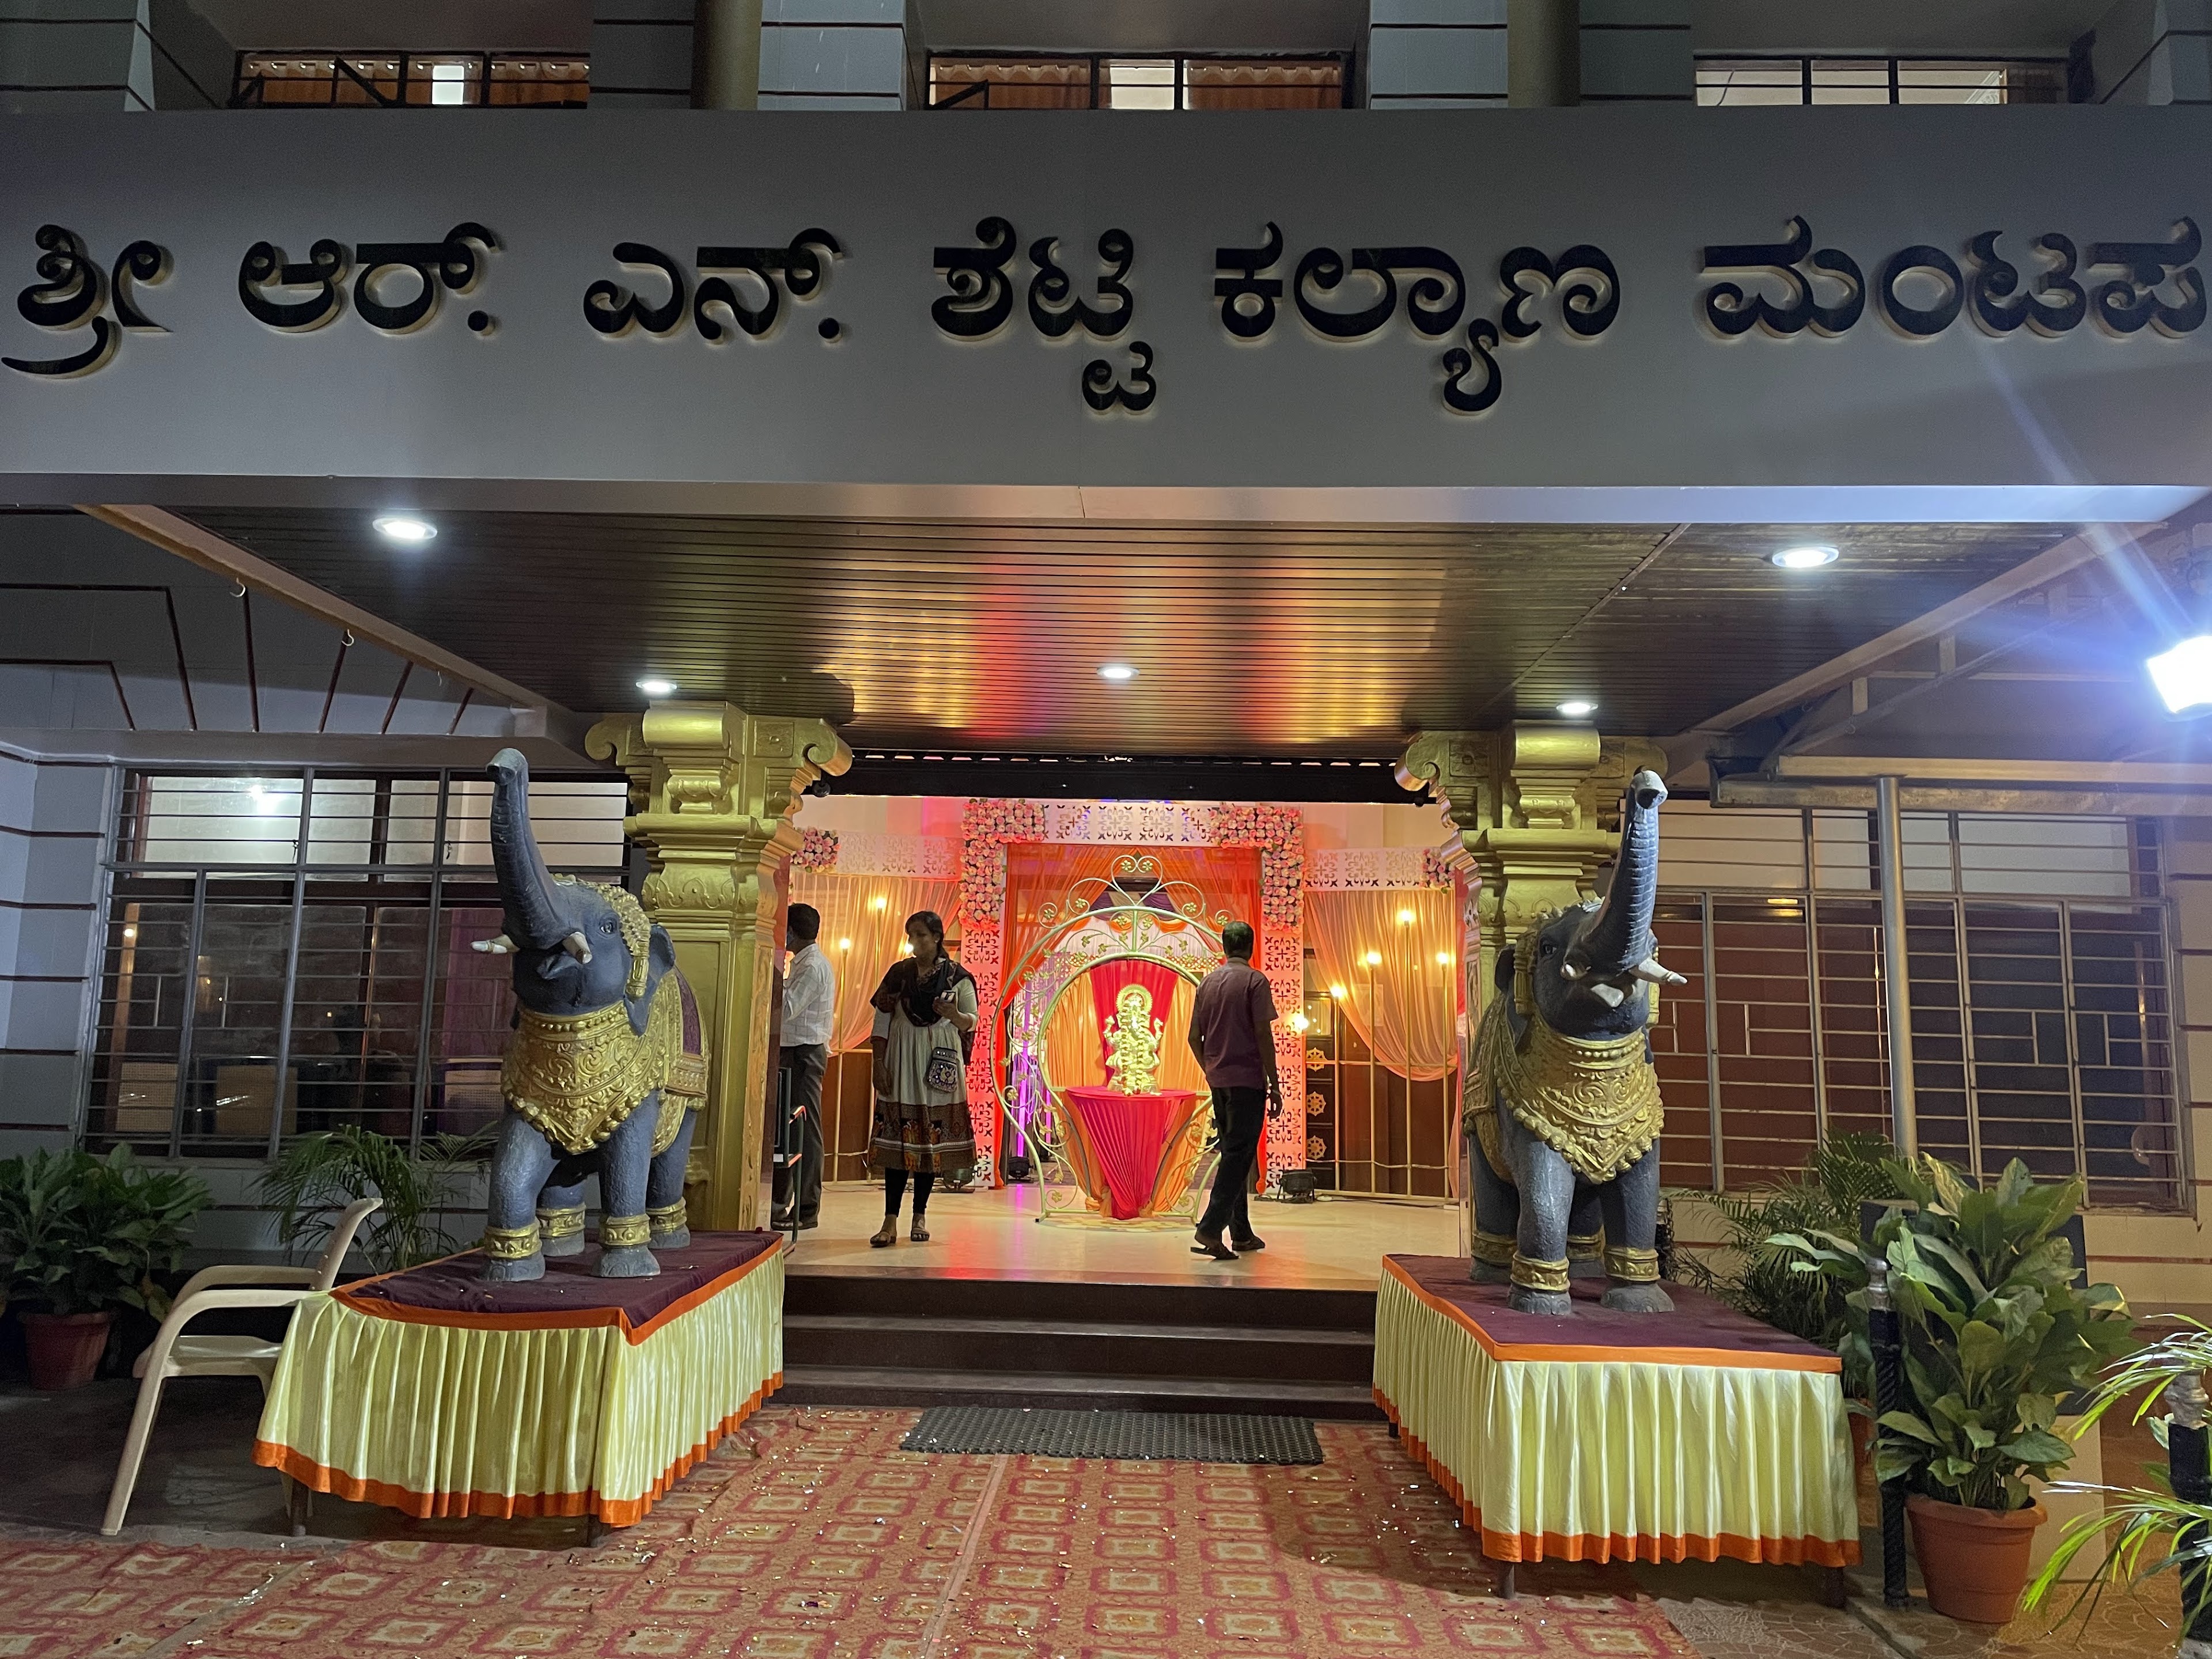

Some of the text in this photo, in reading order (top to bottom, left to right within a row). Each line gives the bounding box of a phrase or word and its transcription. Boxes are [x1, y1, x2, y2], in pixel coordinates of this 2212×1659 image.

[2, 215, 2207, 412] ಶ್ರೀ ಆರ್. ಎನ್. ಶೆಟ್ಟಿ ಕಲ್ಯಾಣ ಮಂಟಪ
